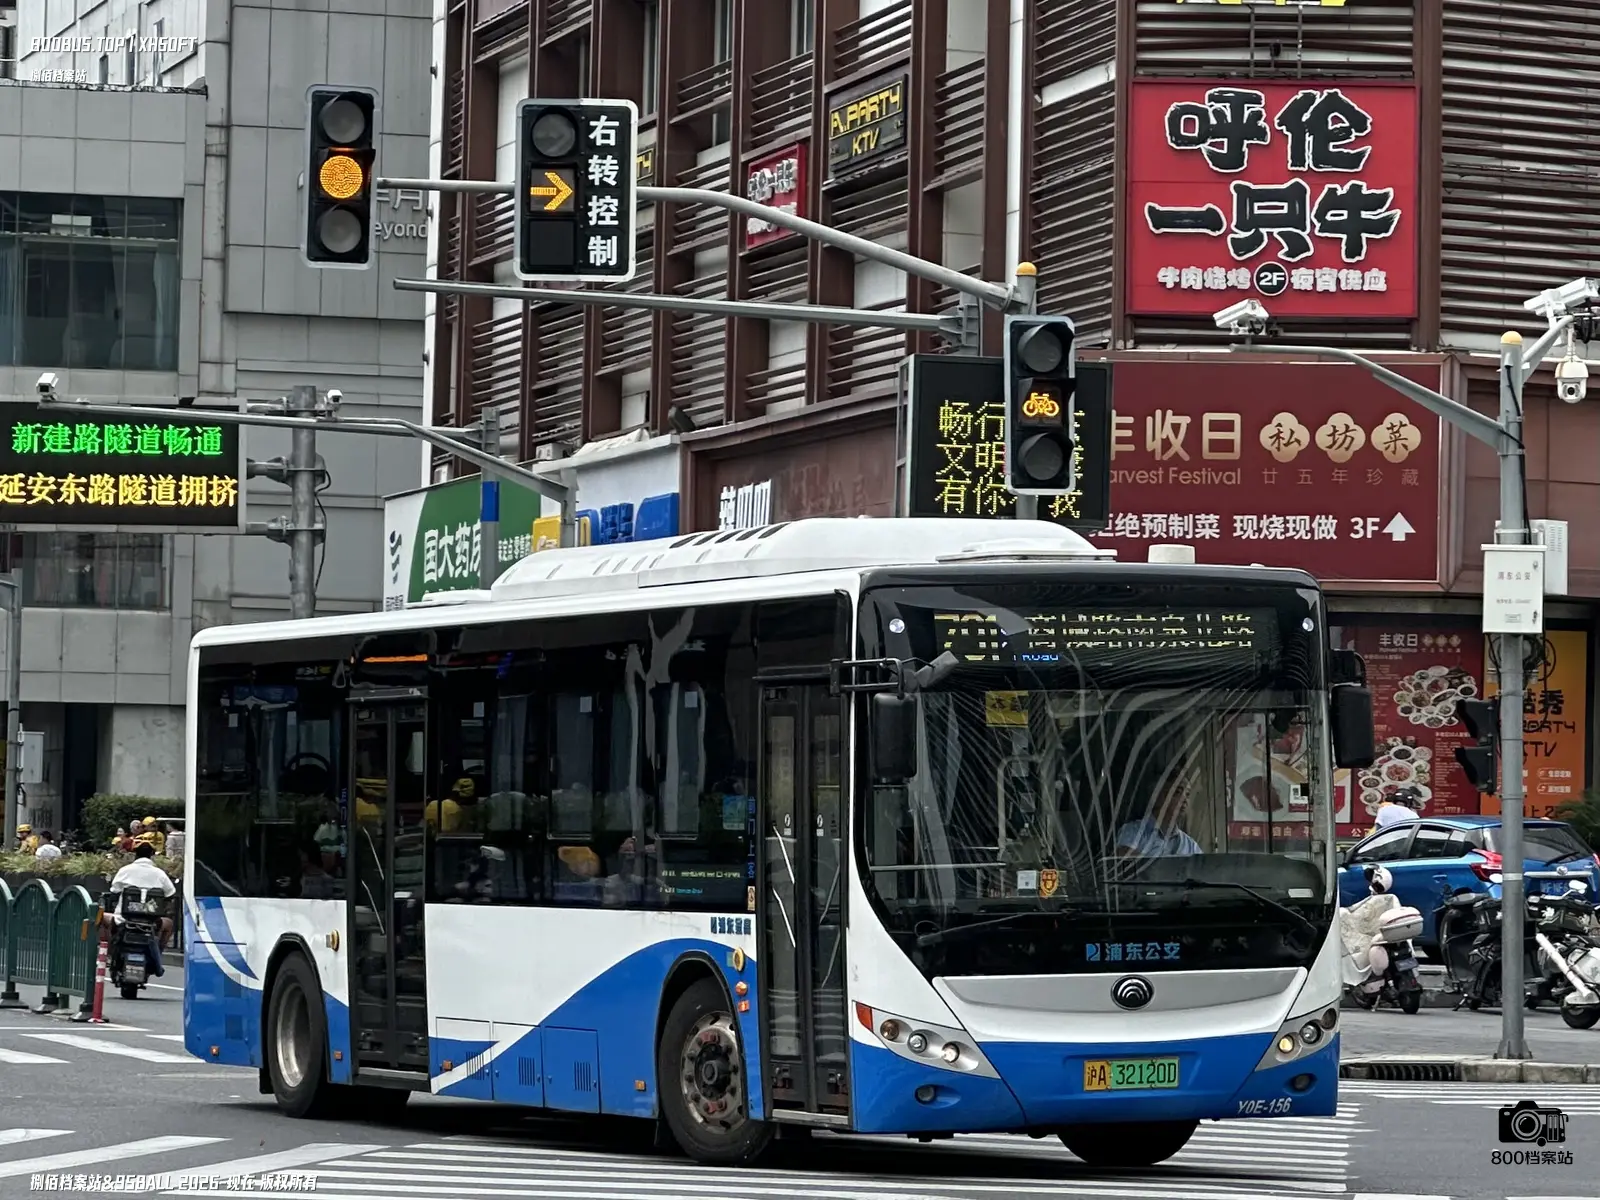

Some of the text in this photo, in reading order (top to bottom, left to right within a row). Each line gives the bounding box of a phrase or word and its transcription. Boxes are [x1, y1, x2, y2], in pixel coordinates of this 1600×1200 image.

[830, 86, 900, 136] A.PARTY
[852, 128, 879, 156] KTV
[1165, 87, 1372, 172] 呼伦
[588, 115, 619, 266] 右转控制
[1144, 178, 1401, 261] 一只牛
[1157, 266, 1251, 290] 牛肉烧烤
[1259, 272, 1285, 286] 2F
[11, 421, 223, 455] 新建路隧道畅通
[1109, 466, 1241, 485] arvest Festival
[1262, 468, 1419, 487] 廿五年珍藏
[0, 472, 238, 507] 延安东路隧道拥挤
[1232, 514, 1338, 539] 现烧现做
[1350, 516, 1380, 539] 3F
[1379, 633, 1418, 647] 丰收日
[1105, 942, 1180, 961] 浦东公交
[1087, 1062, 1177, 1086] 沪A 32120D
